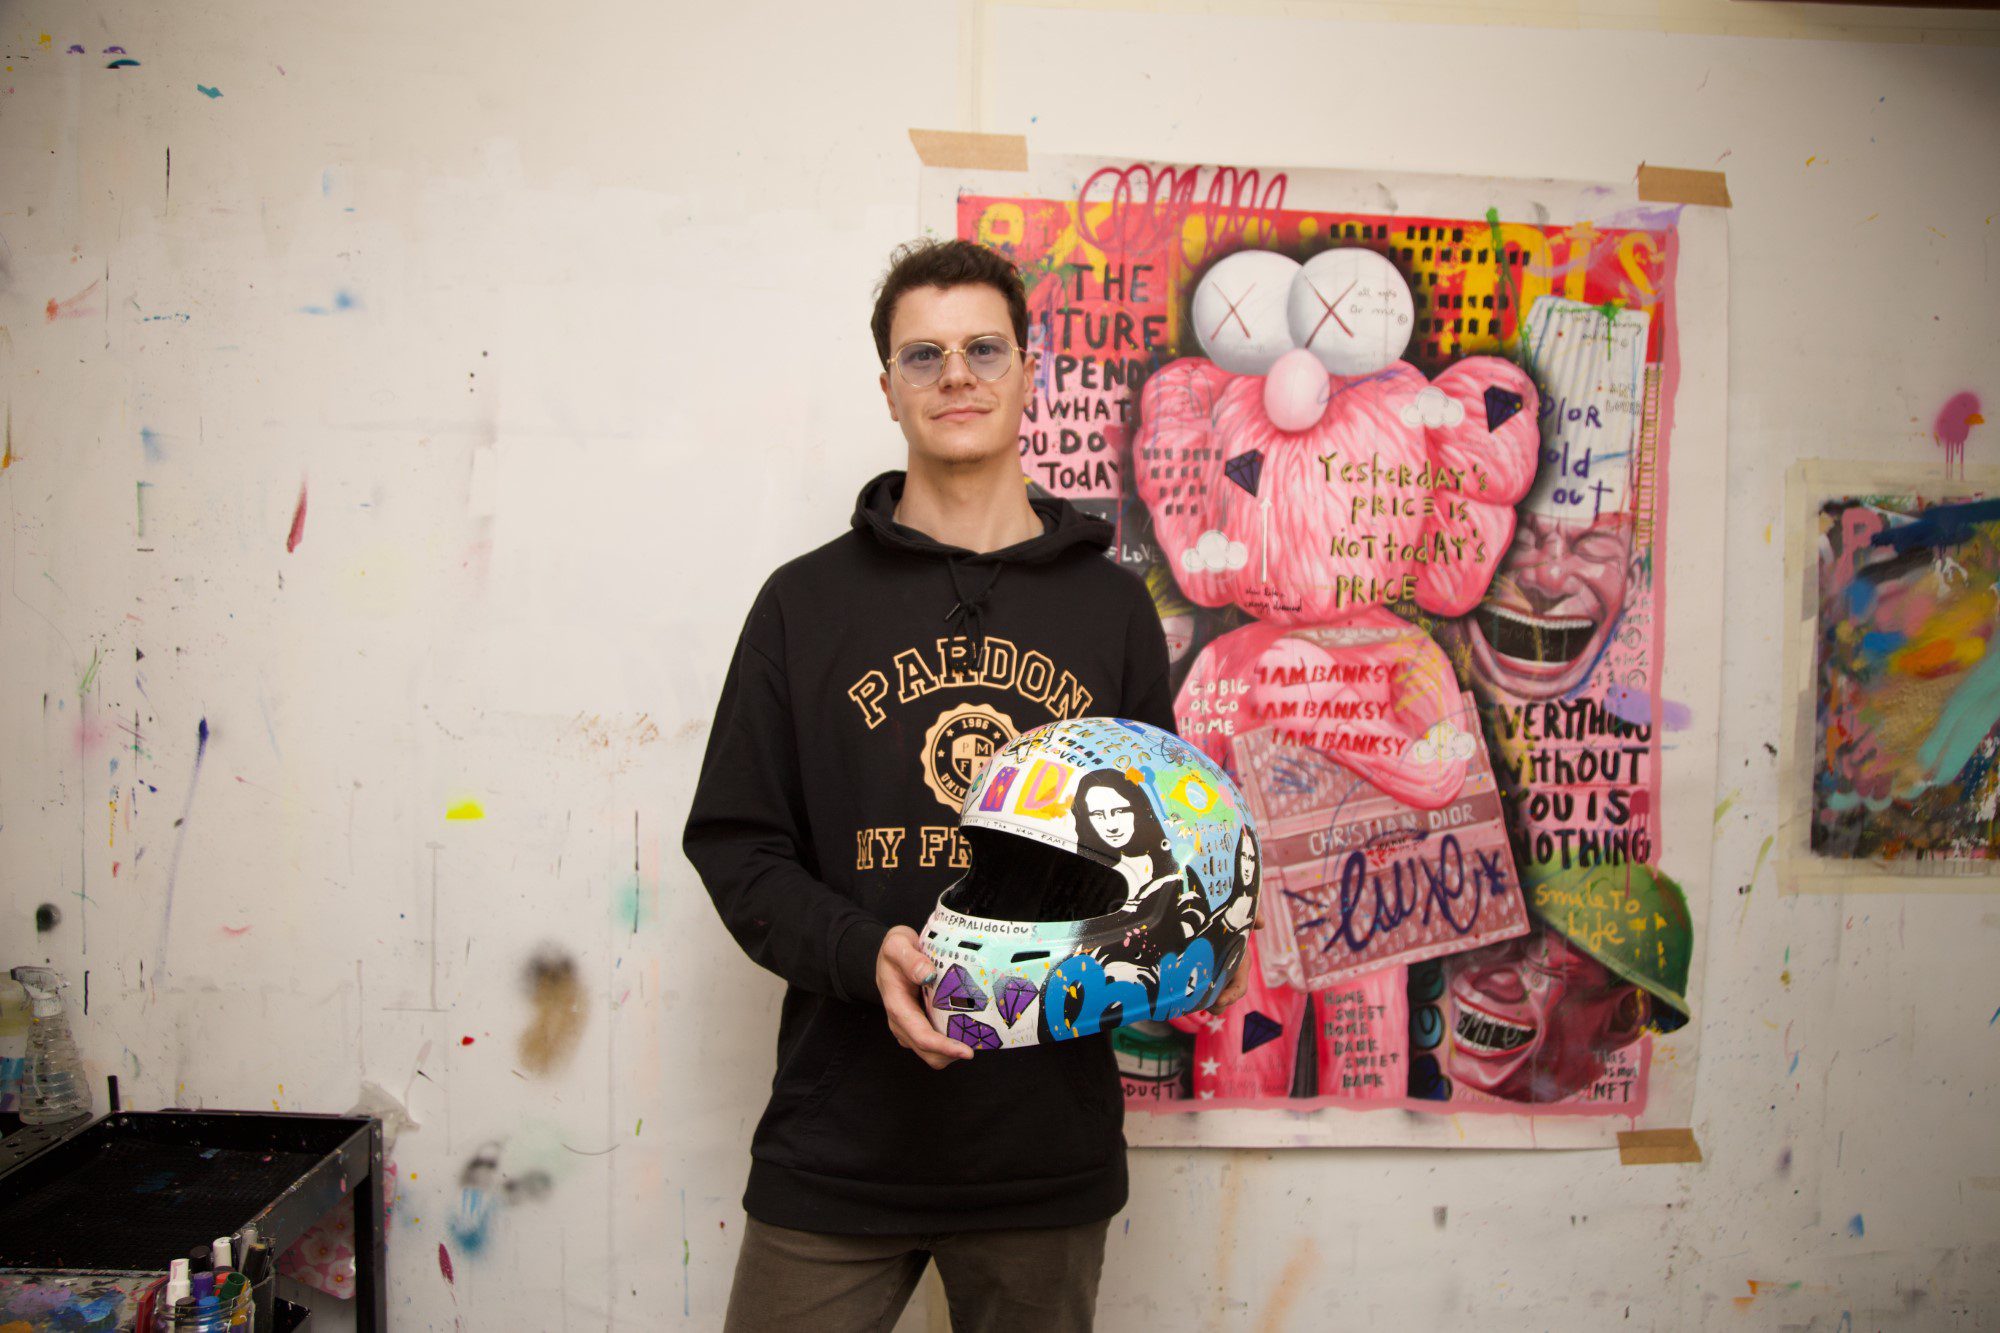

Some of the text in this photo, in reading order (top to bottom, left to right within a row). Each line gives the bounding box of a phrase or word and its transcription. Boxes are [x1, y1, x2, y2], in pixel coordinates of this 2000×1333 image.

[1069, 263, 1155, 302] THE
[1050, 396, 1130, 423] WHAT
[1060, 428, 1107, 454] DO
[1352, 495, 1435, 524] PRICE
[1337, 573, 1419, 609] PRICE
[847, 636, 1093, 730] PARDON
[1188, 679, 1251, 695] GO BIG
[1312, 663, 1399, 685] BANKSY
[1190, 700, 1239, 714] OR GO
[1303, 701, 1391, 720] BANKSY
[961, 718, 990, 730] 1986
[976, 743, 989, 755] M
[1322, 731, 1409, 757] BANKSY
[960, 760, 970, 773] F
[1588, 789, 1630, 825] IS
[1309, 815, 1418, 855] CHRISTIAN
[1427, 803, 1477, 830] DIOR
[856, 828, 905, 870] MY
[1513, 828, 1651, 870] NOTHING
[1593, 1081, 1633, 1103] NFT
